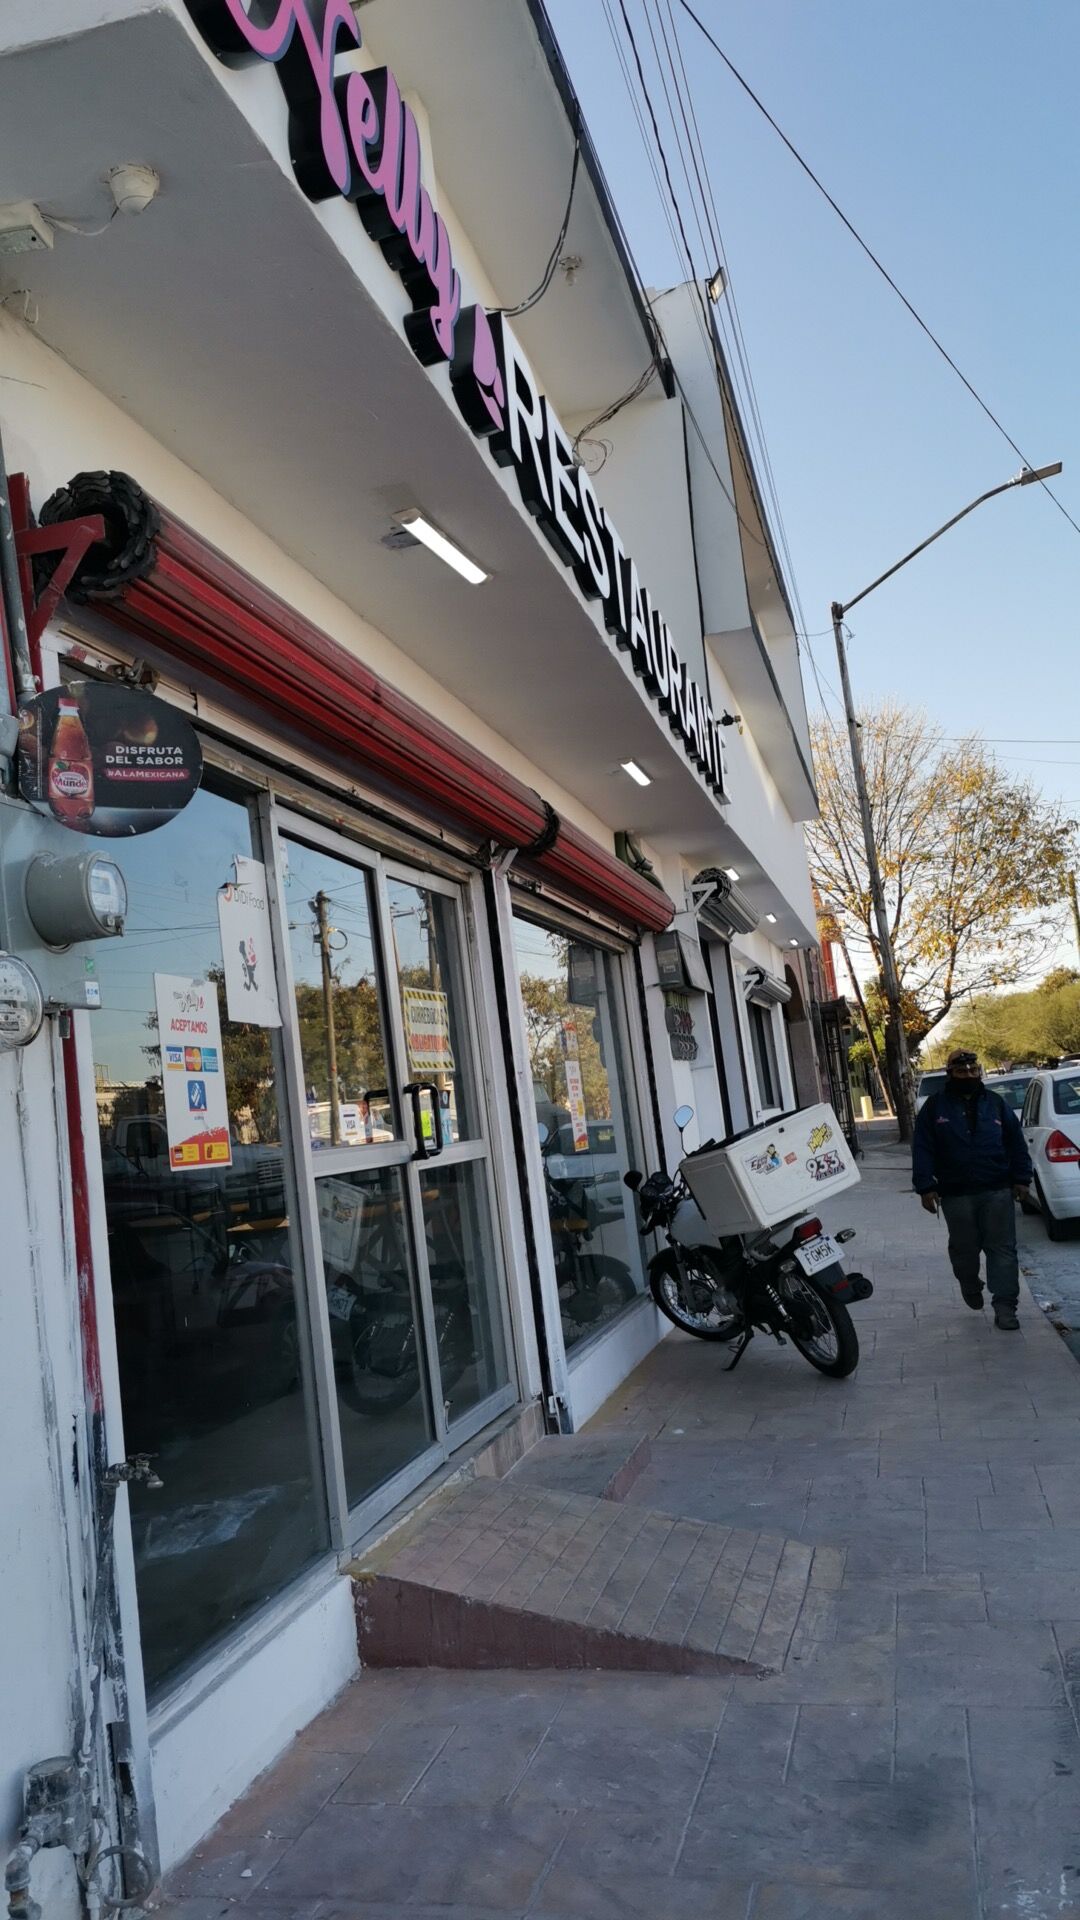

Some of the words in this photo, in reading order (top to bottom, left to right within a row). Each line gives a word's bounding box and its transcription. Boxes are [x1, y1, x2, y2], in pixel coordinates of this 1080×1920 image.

[500, 311, 732, 801] RESTAURANTE
[115, 746, 183, 755] DISFRUTA
[105, 755, 132, 764] DEL
[136, 756, 184, 765] SABOR
[170, 1018, 208, 1034] ACEPTAMOS
[169, 1053, 182, 1063] VISA
